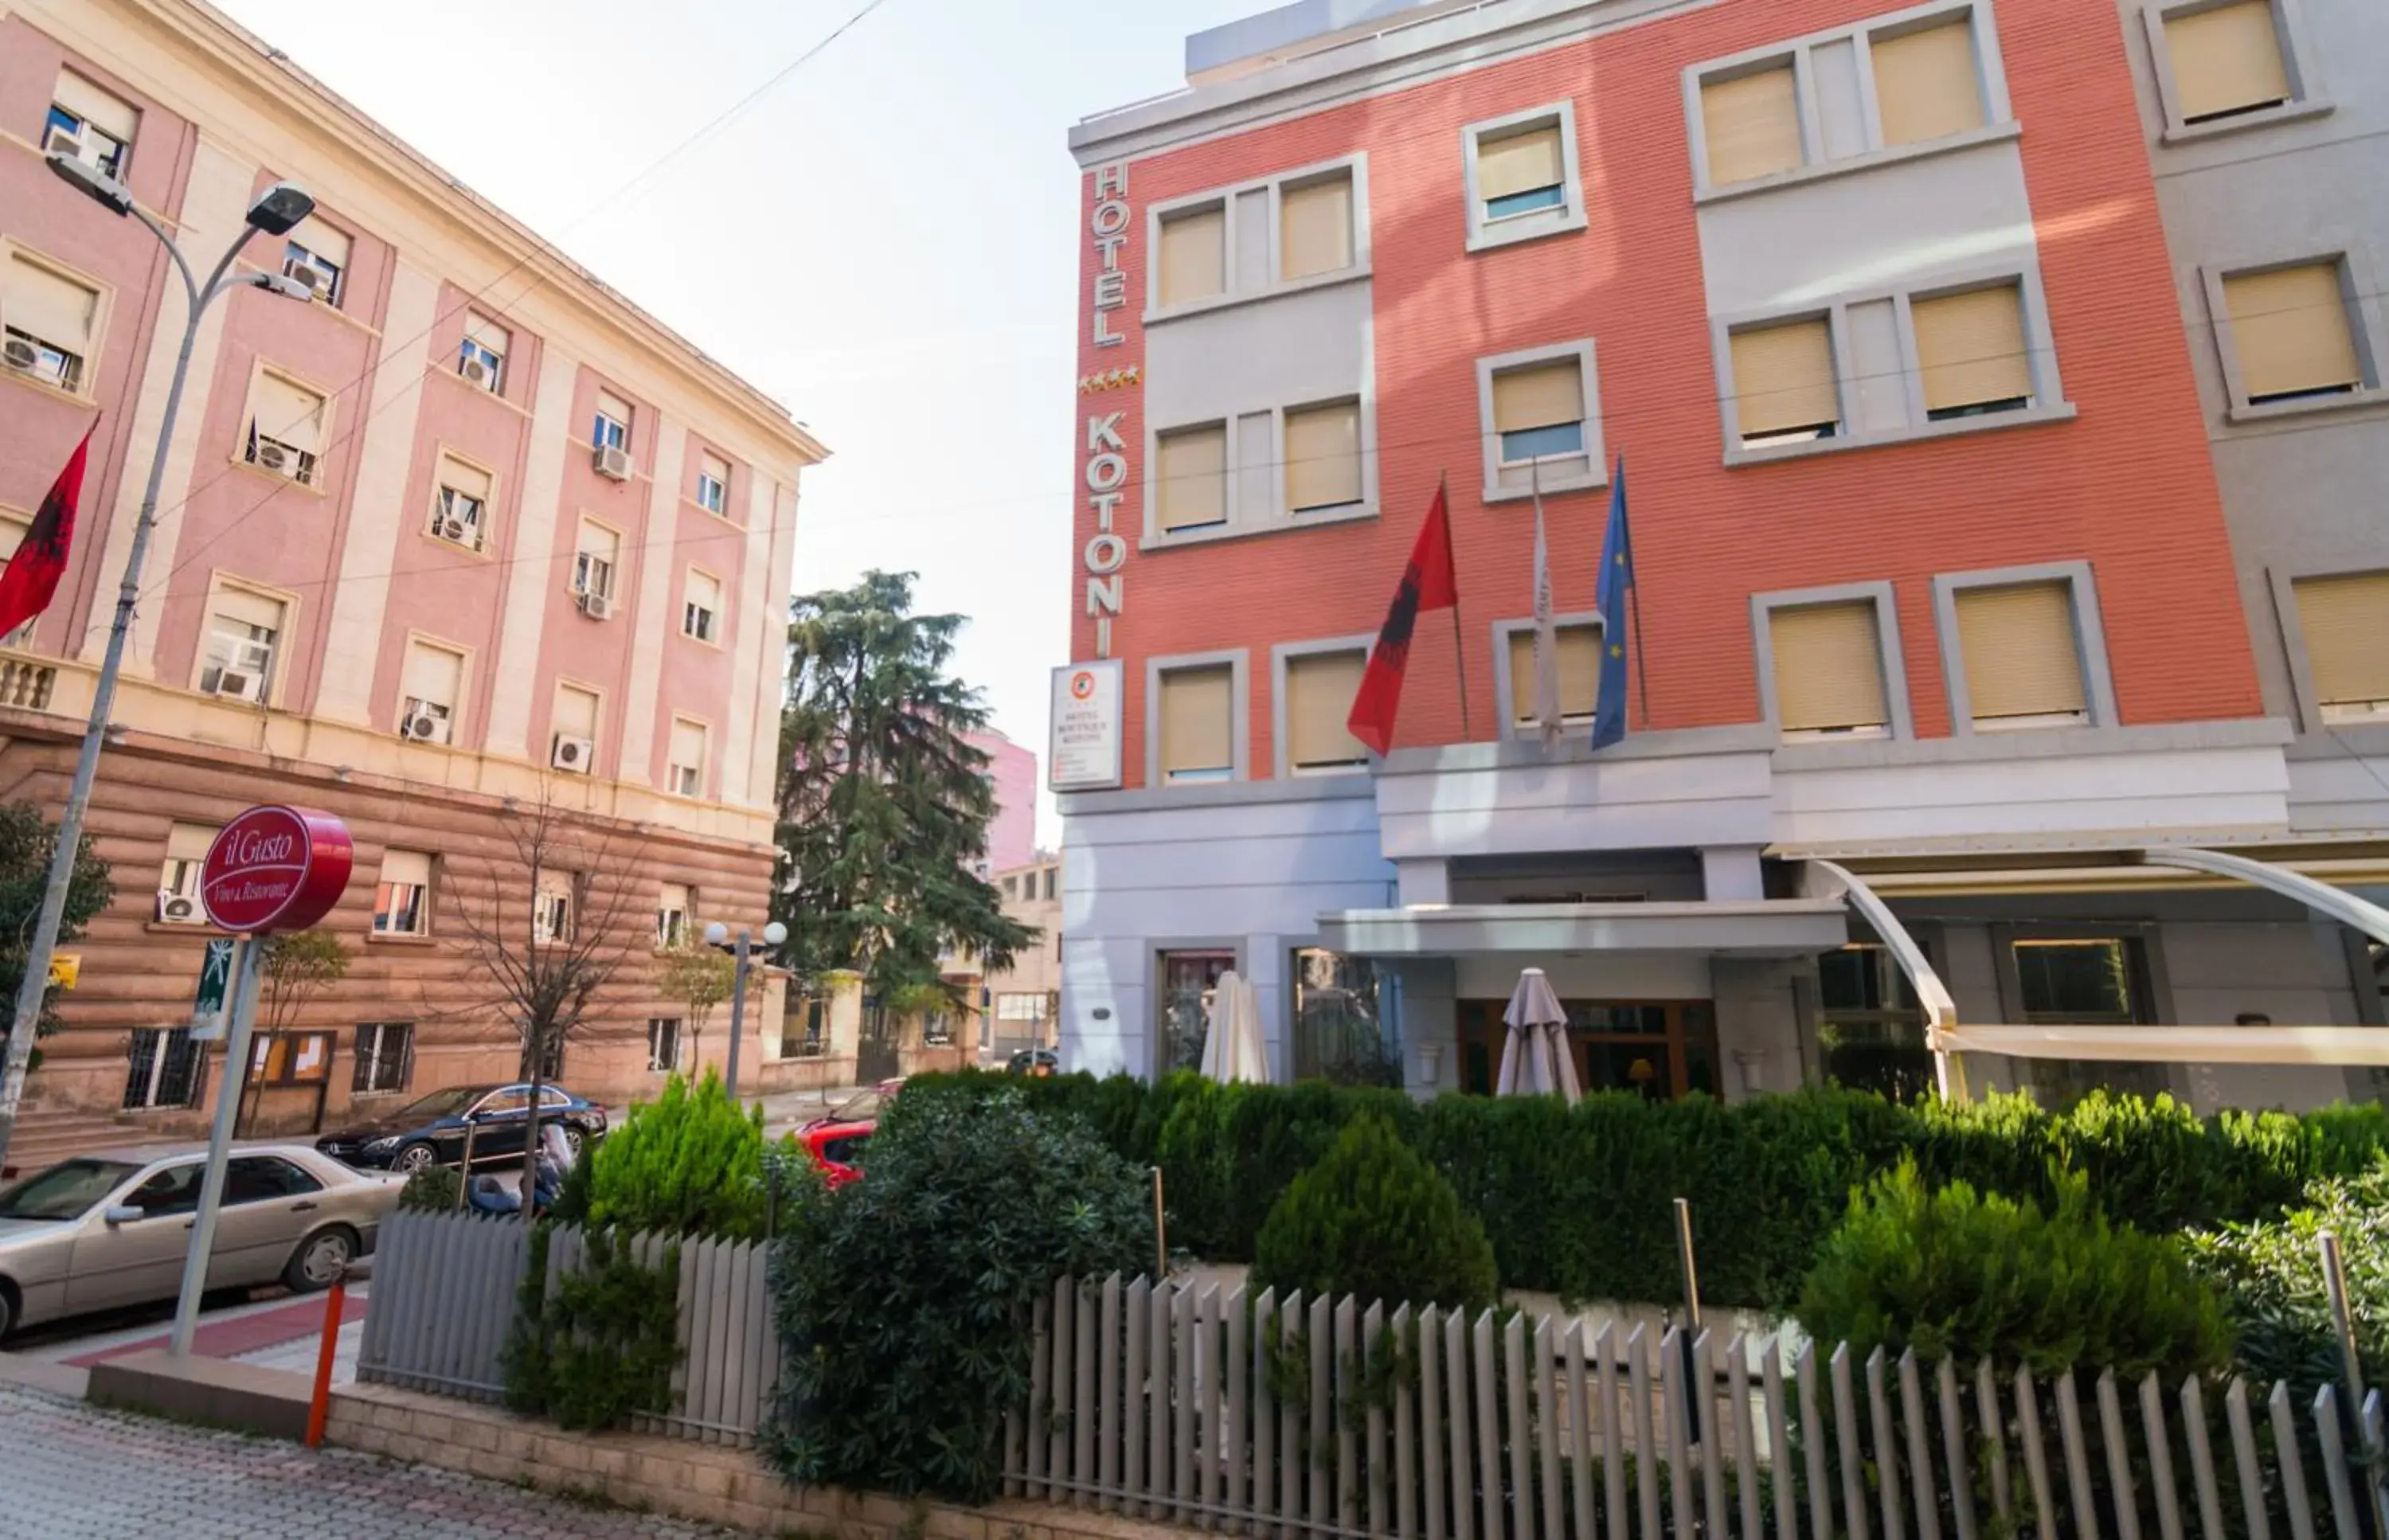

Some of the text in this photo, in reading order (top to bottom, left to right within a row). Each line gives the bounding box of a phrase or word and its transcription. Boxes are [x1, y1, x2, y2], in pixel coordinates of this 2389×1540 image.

[1085, 162, 1130, 659] HOTEL KOTONI
[225, 829, 292, 866] il Gusto
